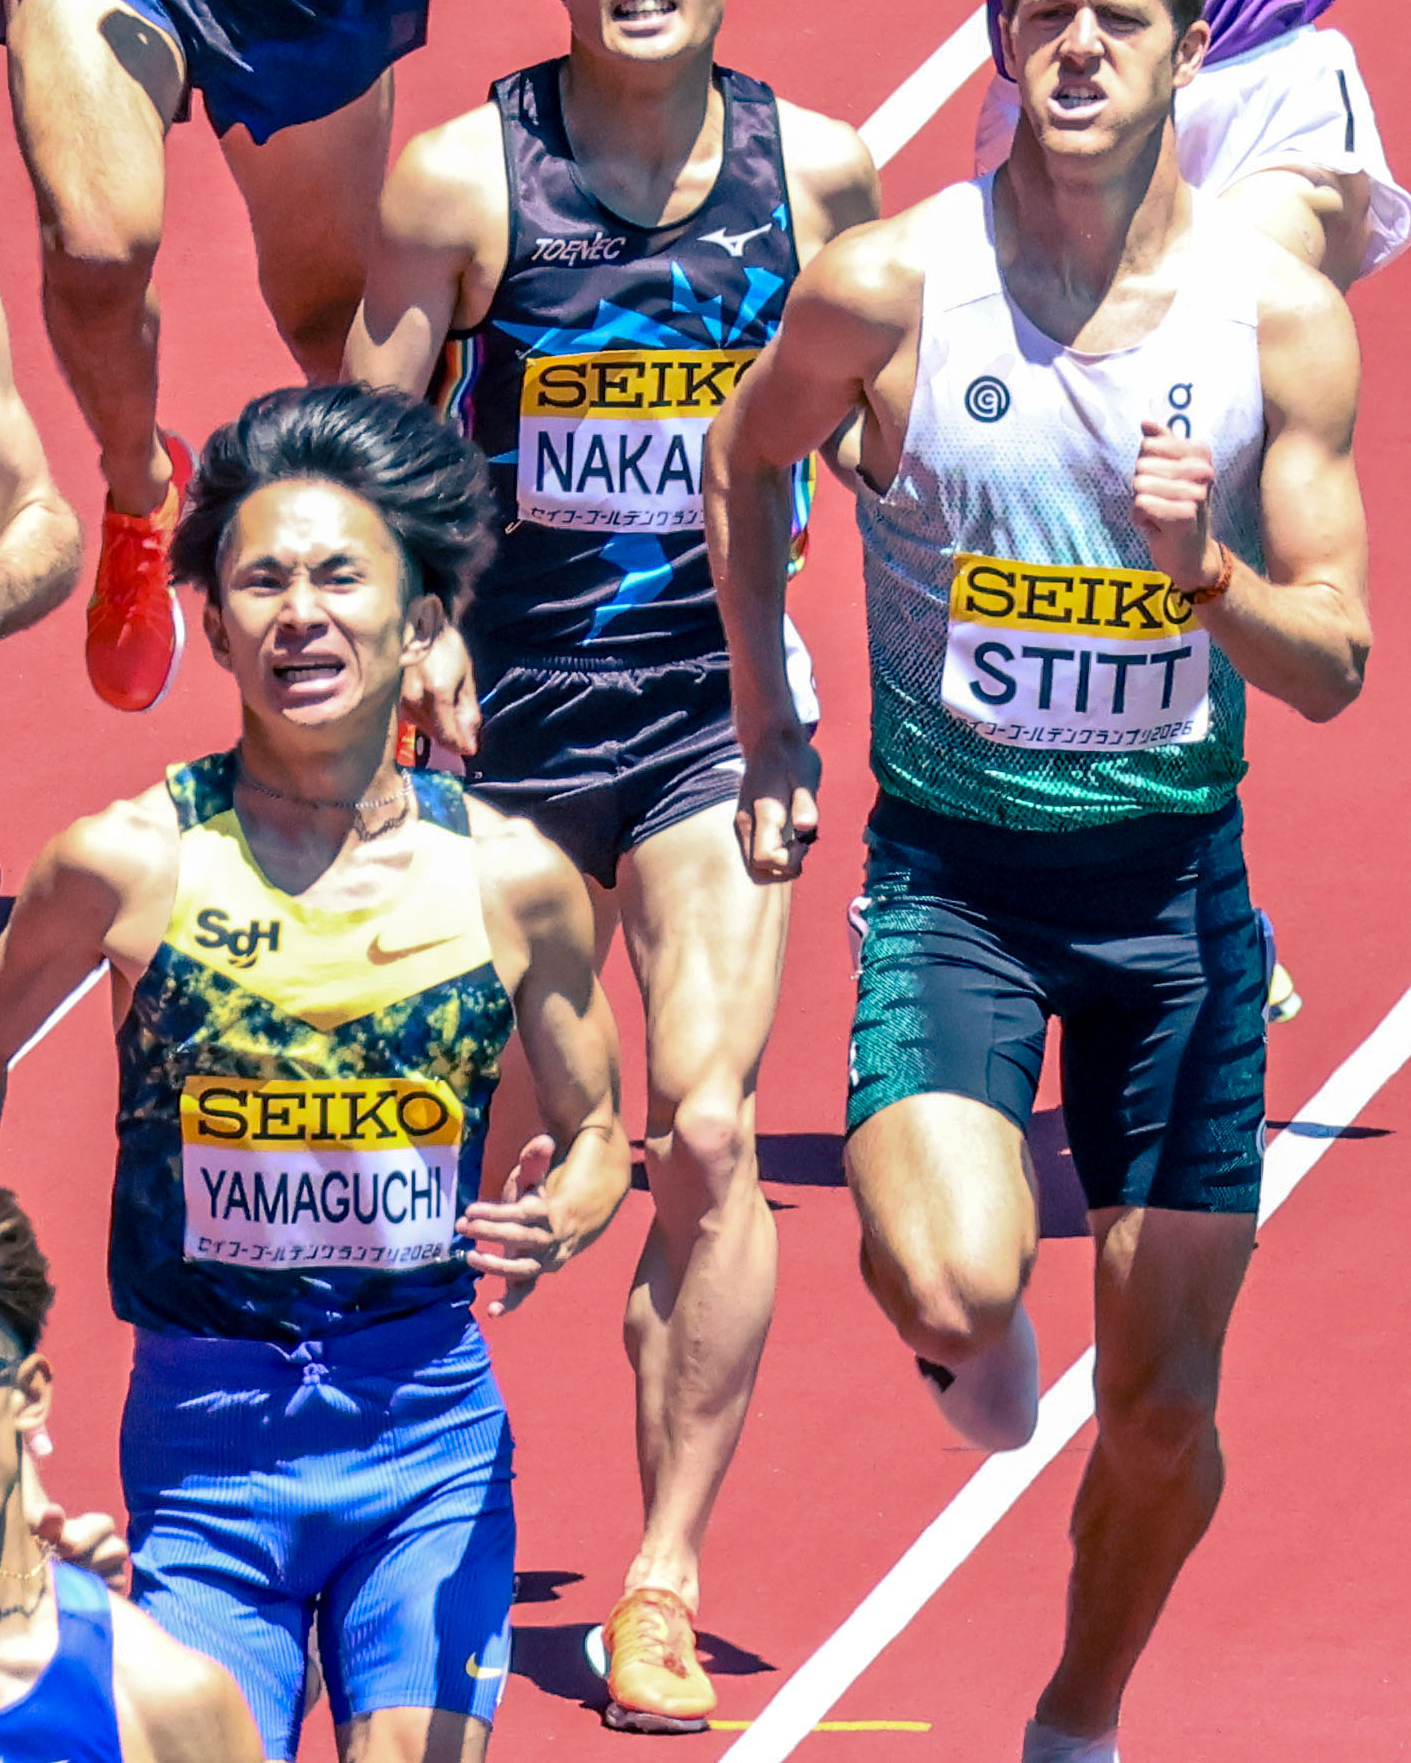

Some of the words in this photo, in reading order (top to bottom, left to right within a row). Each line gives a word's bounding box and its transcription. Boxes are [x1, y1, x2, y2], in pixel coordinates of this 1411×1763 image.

[537, 359, 756, 409] SEIK
[536, 431, 705, 495] NAKA
[531, 507, 705, 526] セイコーゴールデングラン
[969, 641, 1192, 714] STITT
[198, 1088, 449, 1141] SEIKO
[200, 1166, 441, 1225] YAMAGUCHI
